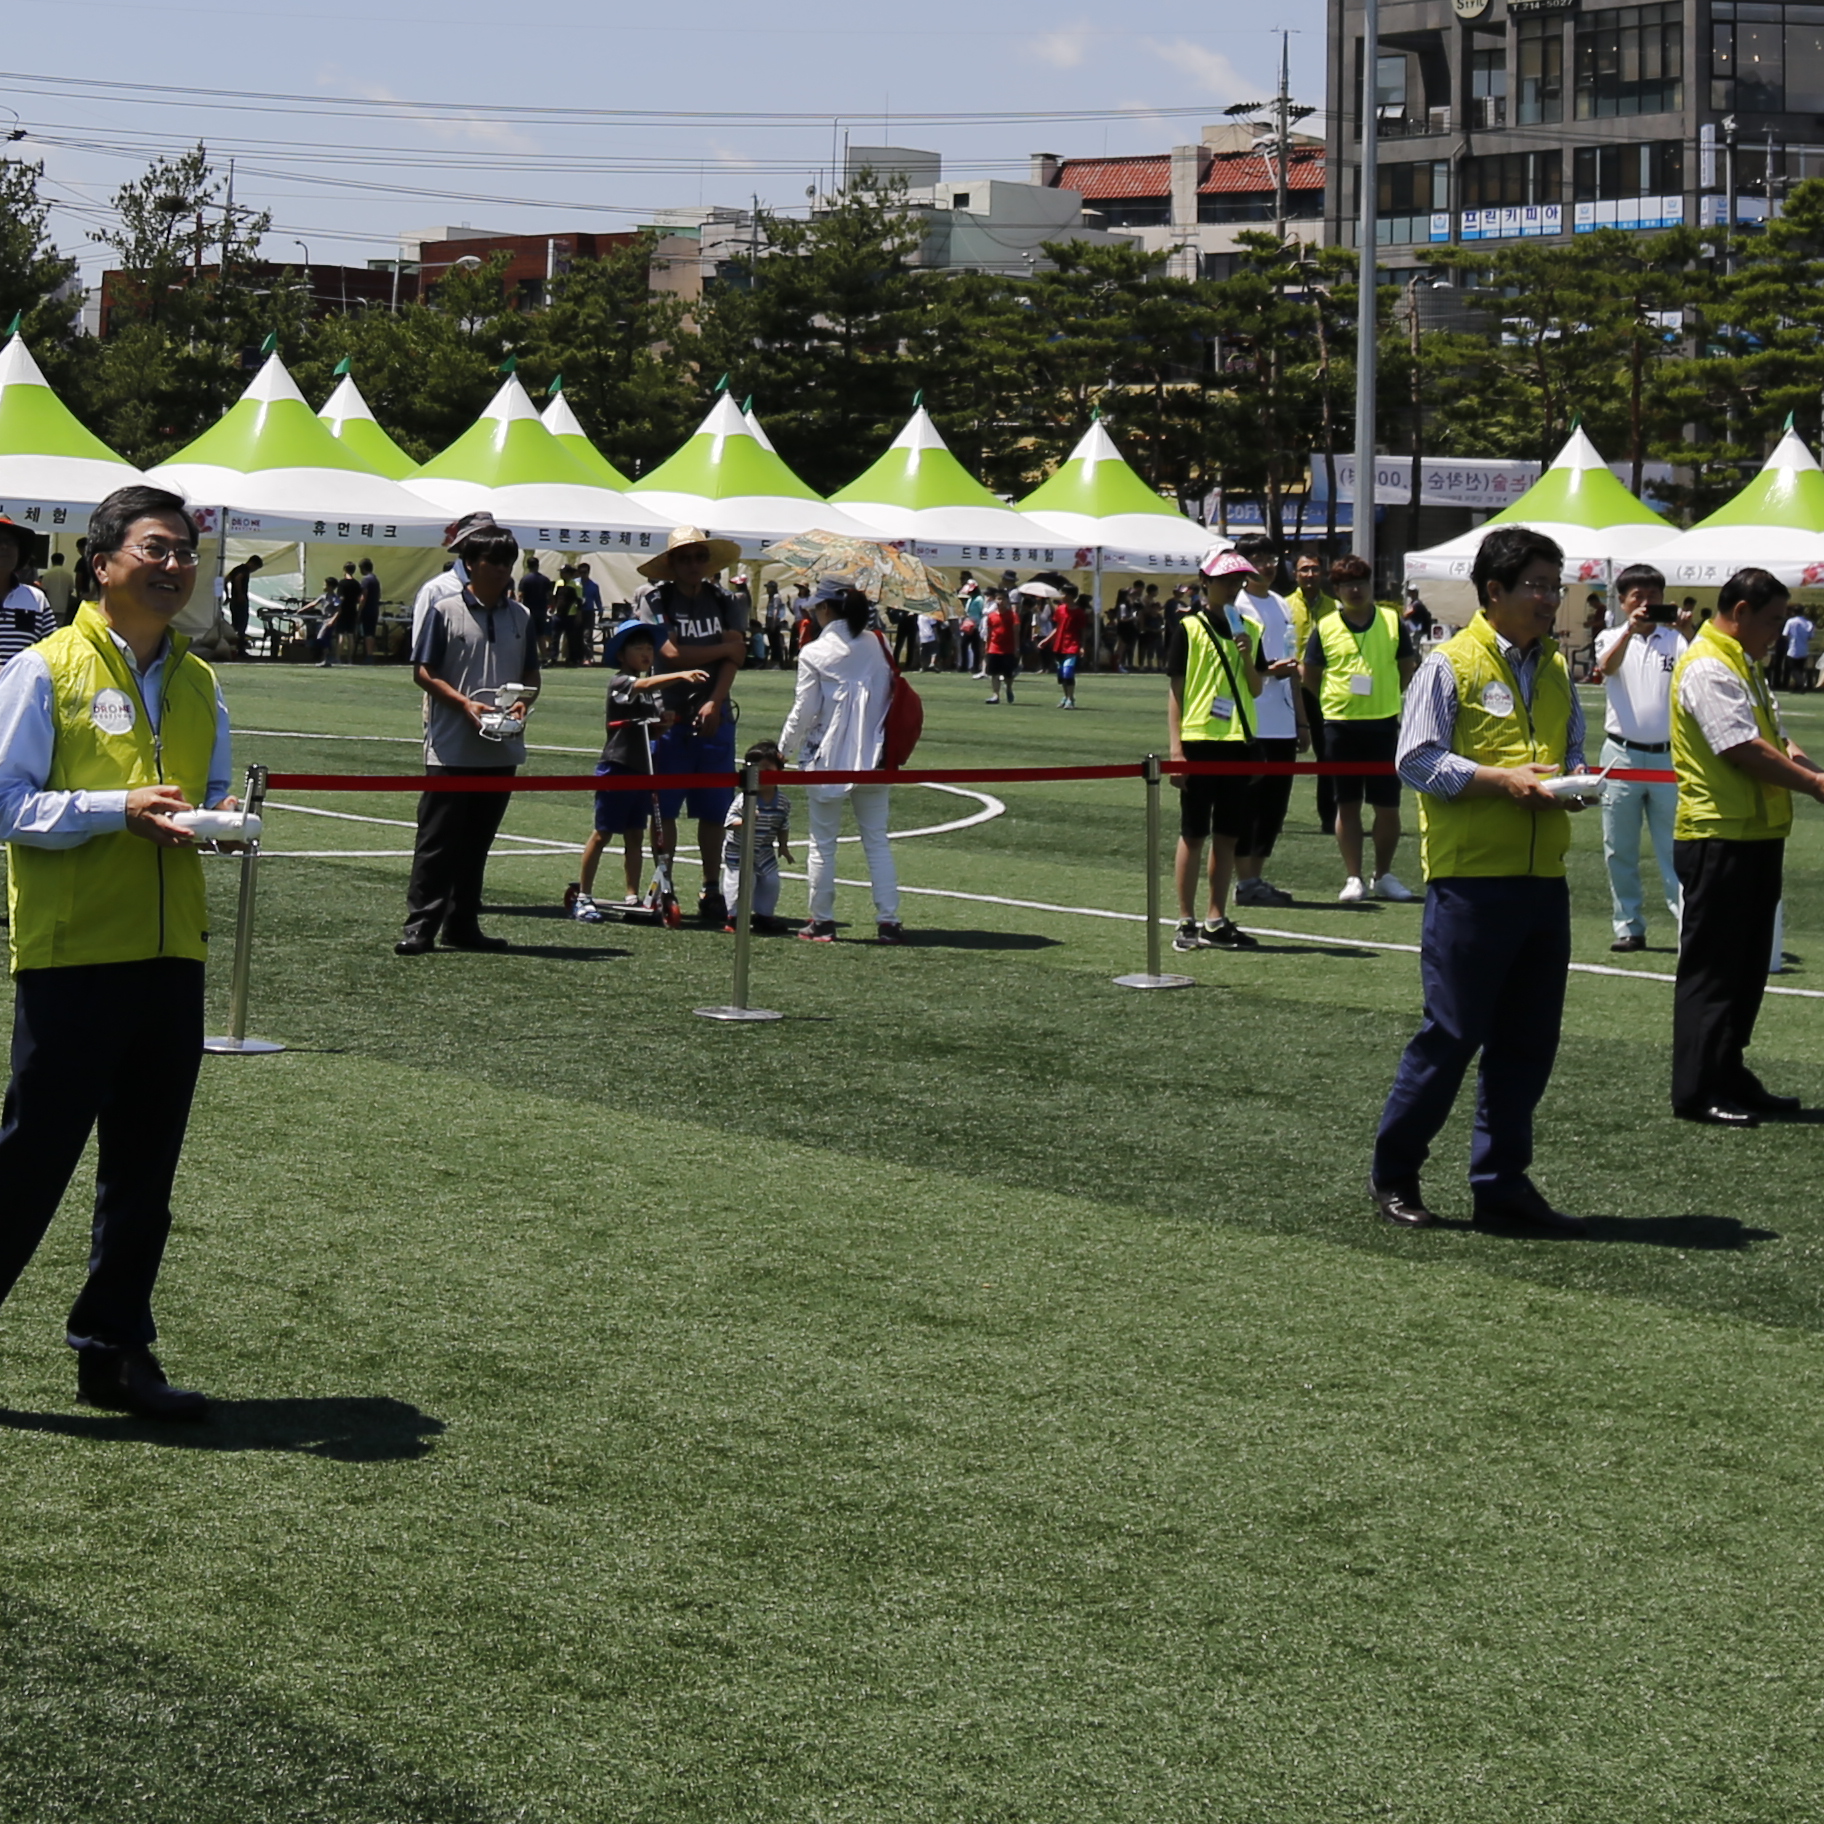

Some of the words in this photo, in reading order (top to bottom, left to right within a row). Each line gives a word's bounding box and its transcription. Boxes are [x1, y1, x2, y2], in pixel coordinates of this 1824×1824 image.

[1465, 204, 1559, 229] 프린키피아
[24, 506, 68, 524] 체험
[232, 518, 261, 527] DRONE
[312, 520, 398, 539] 휴먼테크
[538, 528, 651, 547] 드론조종체험
[961, 546, 1055, 563] 드론조종체험
[94, 704, 131, 713] DRONE
